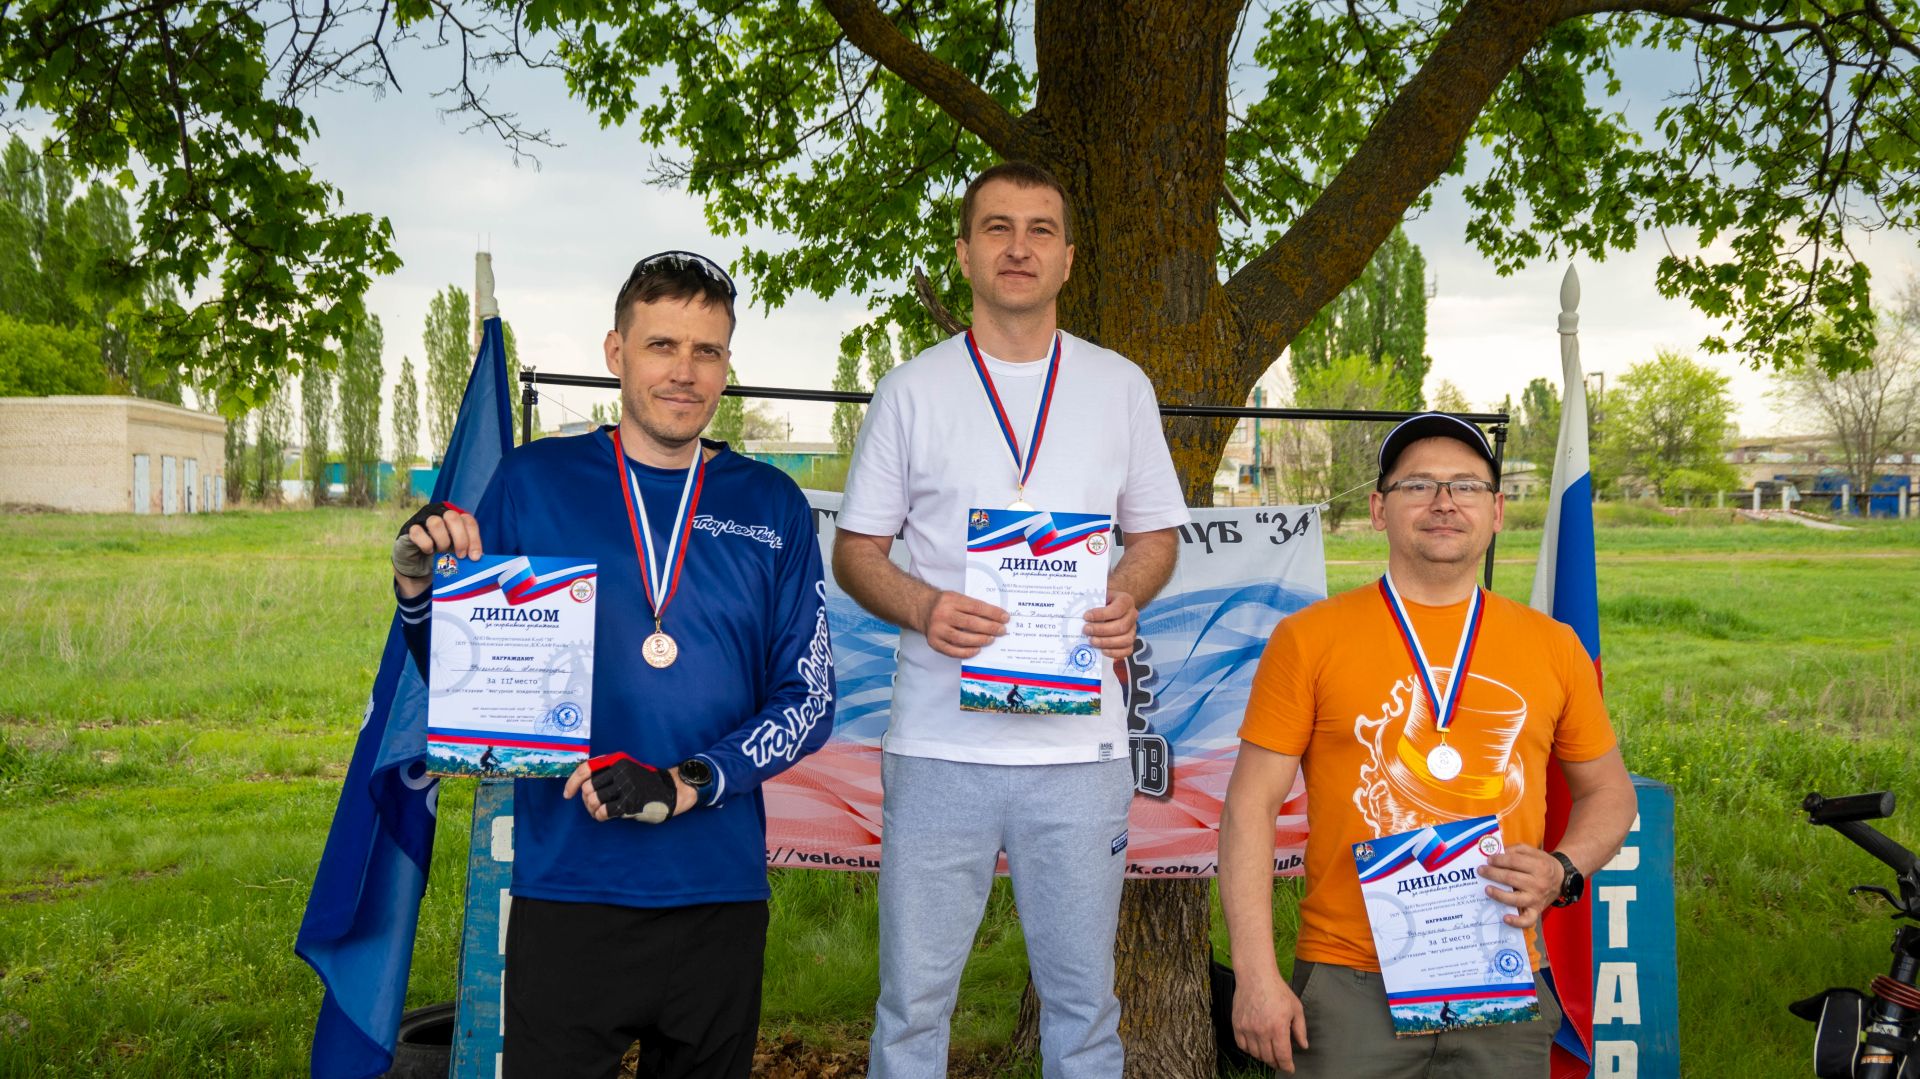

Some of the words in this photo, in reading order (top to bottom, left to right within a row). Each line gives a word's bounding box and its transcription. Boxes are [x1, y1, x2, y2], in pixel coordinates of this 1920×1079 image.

[693, 515, 723, 537] Troy
[724, 520, 752, 536] Lee
[999, 558, 1077, 572] ДИПЛОМ
[470, 607, 559, 622] ДИПЛОМ
[1397, 867, 1477, 895] ДИПЛОМ
[1449, 934, 1471, 943] место
